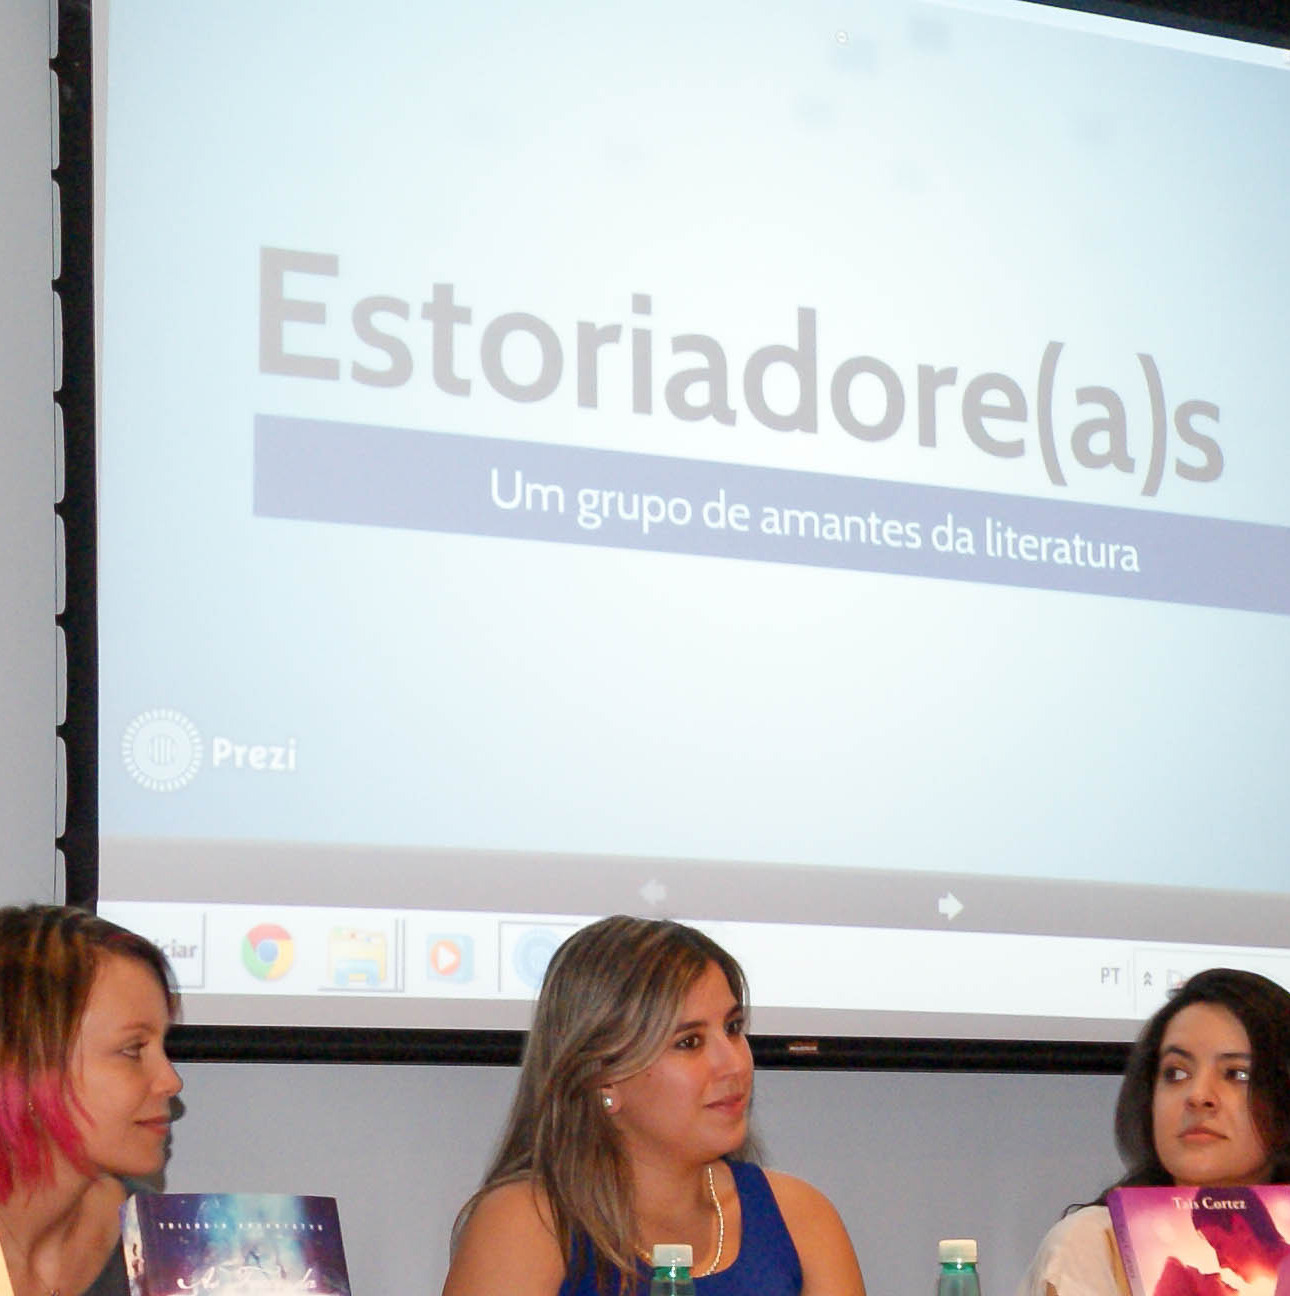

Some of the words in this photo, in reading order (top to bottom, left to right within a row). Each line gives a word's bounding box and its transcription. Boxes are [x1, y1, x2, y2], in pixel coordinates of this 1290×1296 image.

[258, 244, 1225, 497] Estoriadore(a)s
[490, 468, 566, 516] Um
[577, 481, 692, 534] grupo
[703, 488, 751, 532] de
[760, 500, 921, 551] amantes
[931, 510, 975, 555] da
[984, 517, 1140, 573] literatura
[212, 736, 295, 771] Prezi
[1100, 967, 1121, 985] PT
[1202, 1196, 1246, 1210] Cortez
